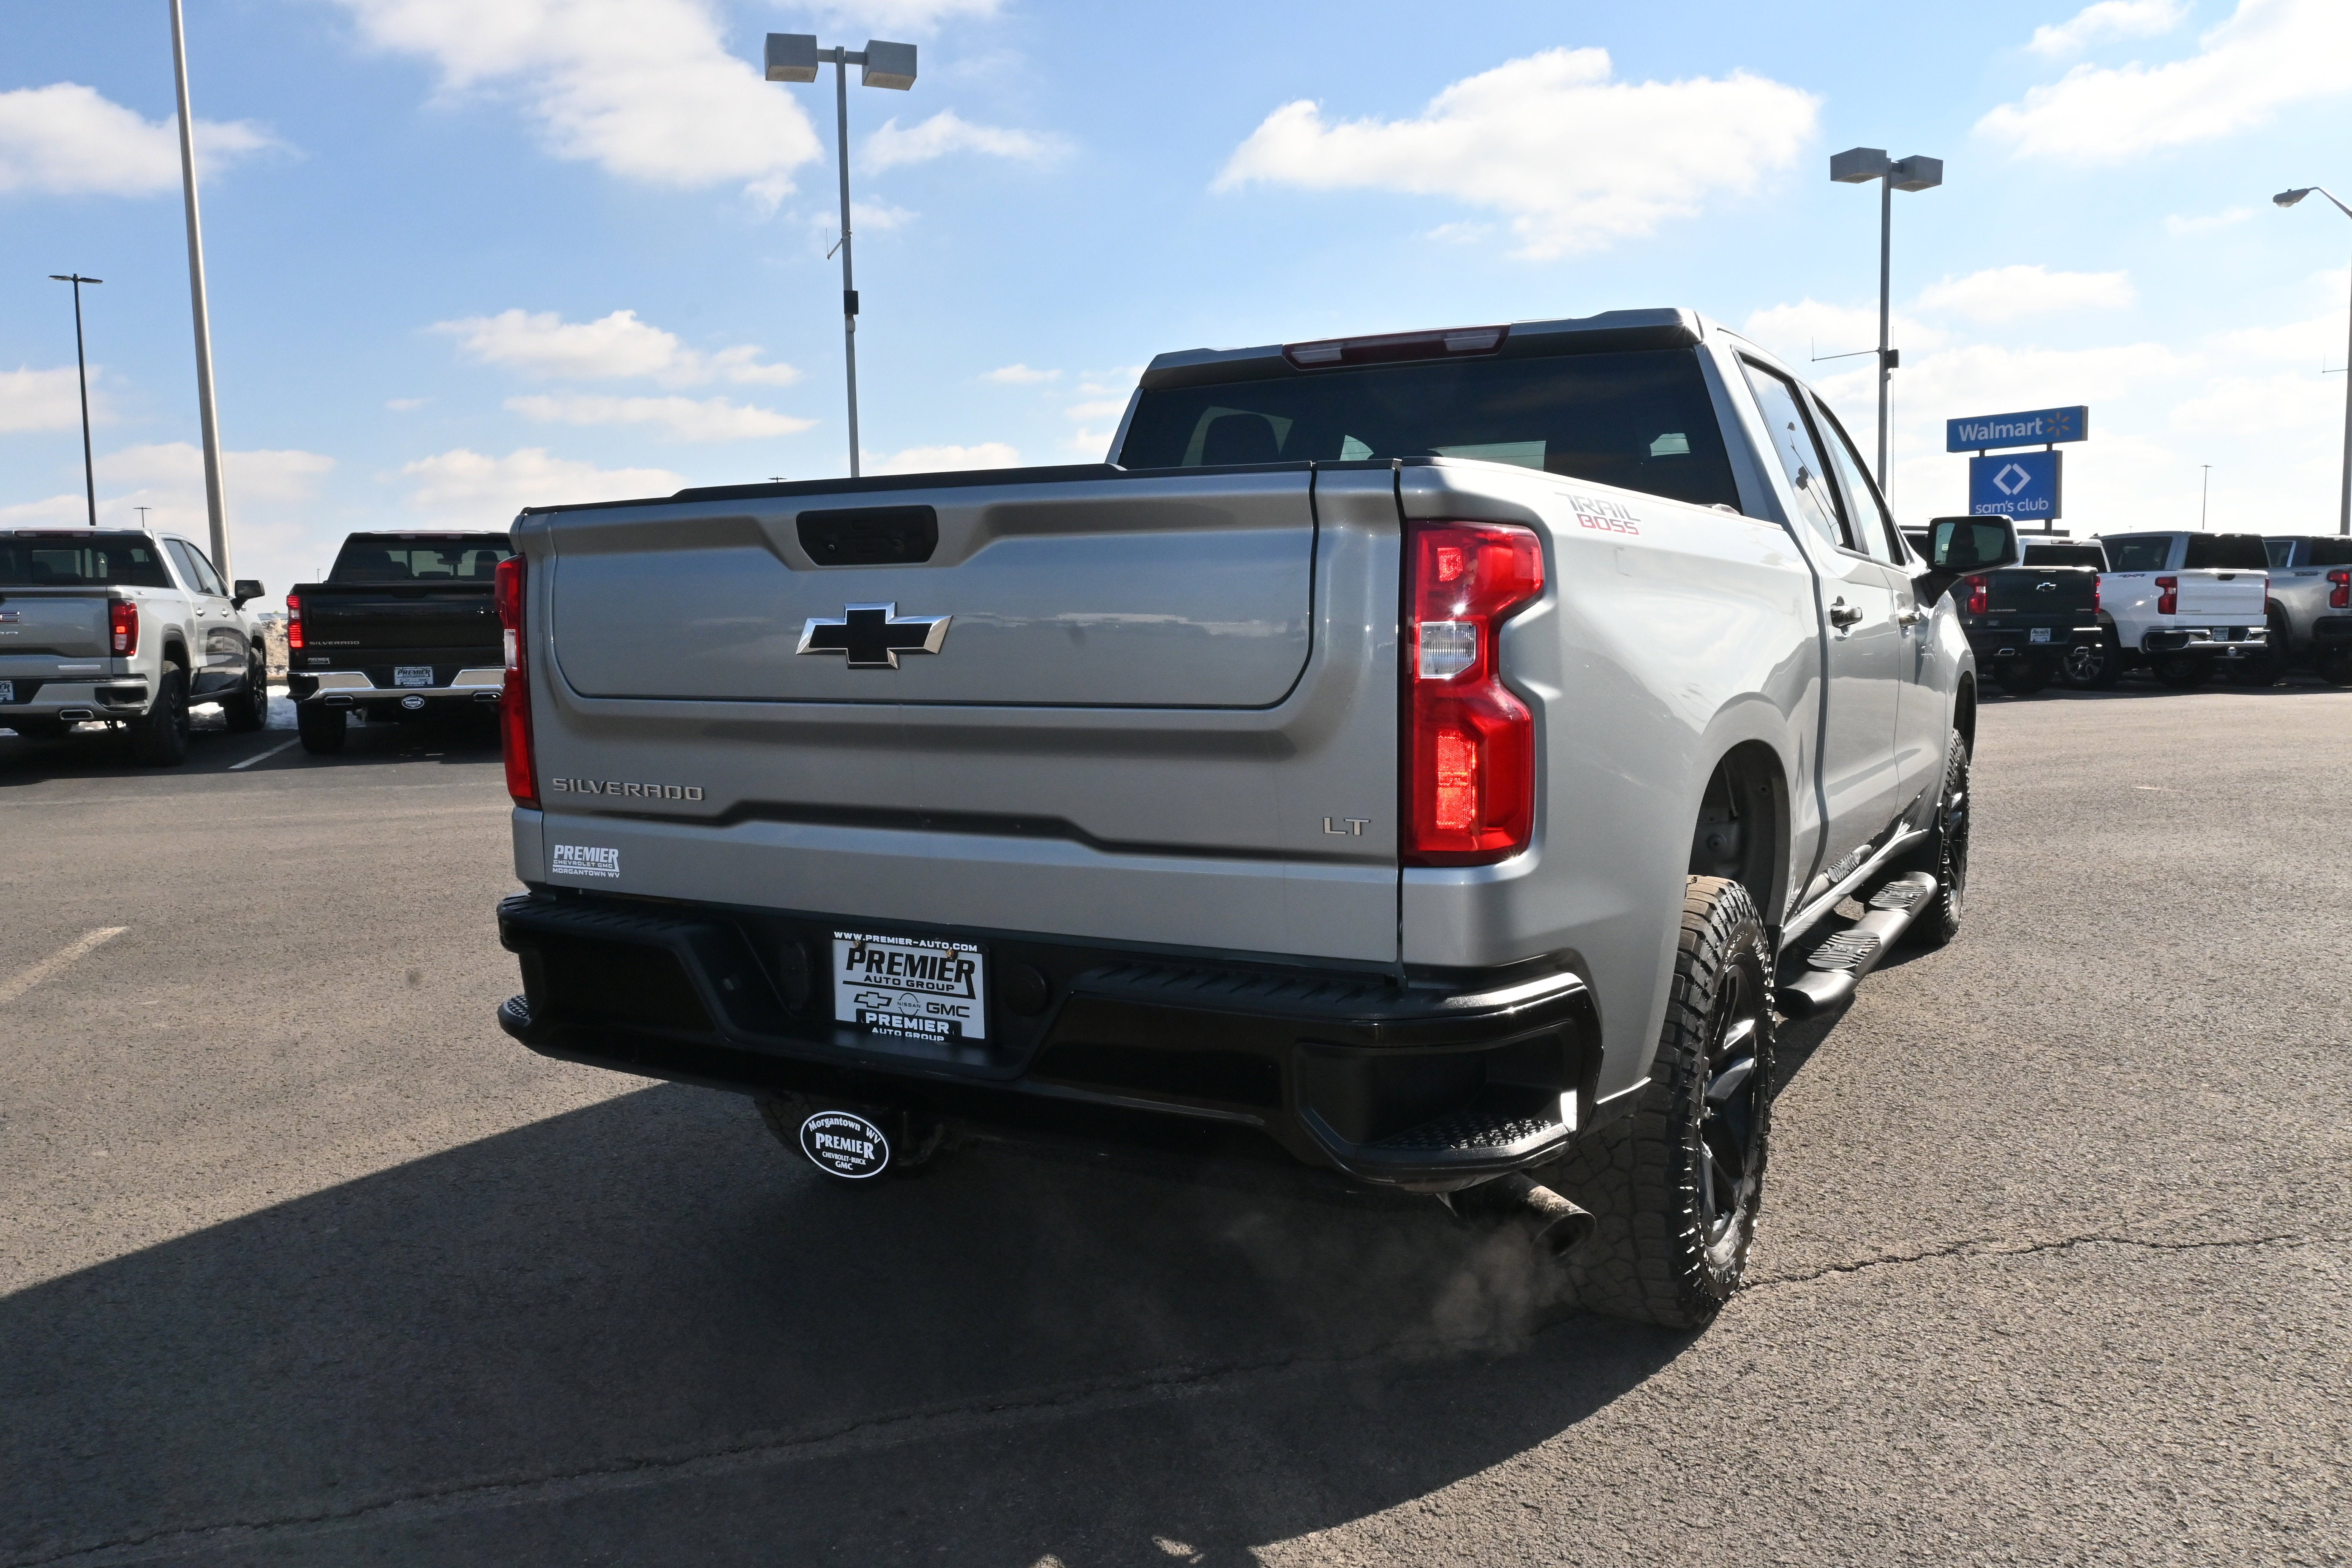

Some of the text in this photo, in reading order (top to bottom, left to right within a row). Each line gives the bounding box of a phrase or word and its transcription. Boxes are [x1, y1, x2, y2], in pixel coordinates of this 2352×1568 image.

[1959, 418, 2042, 441] Walmart
[1554, 492, 1641, 522] TRAIL
[1975, 498, 2049, 514] sam's club
[1576, 513, 1639, 535] BOSS
[553, 778, 705, 800] SILVERADO
[1323, 817, 1371, 836] LT
[553, 859, 596, 867] CHEVROLET
[554, 845, 619, 864] PREMIER
[553, 867, 606, 877] MORGANTOWN
[834, 931, 977, 952] WWW.PREMIER-AUTO.COM
[846, 947, 975, 985] PREMIER
[864, 975, 955, 991] AUTO GROUP
[926, 1002, 970, 1018] GMC
[866, 1012, 950, 1034] PREMIER
[871, 1027, 945, 1041] AUTO GROUP
[808, 1117, 881, 1144] Morgantown WV
[815, 1132, 875, 1160] PREMIER
[835, 1161, 853, 1170] GMC
